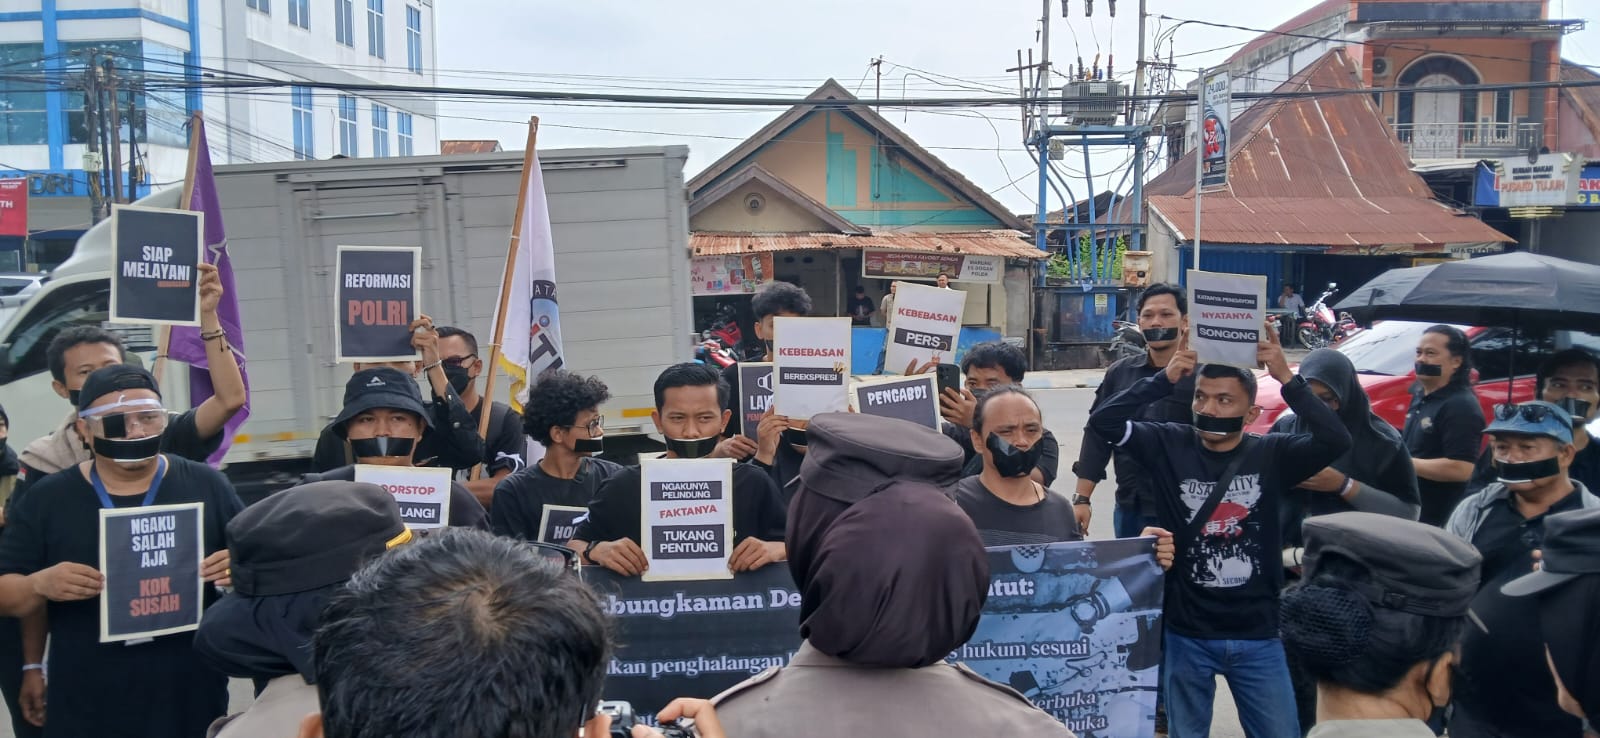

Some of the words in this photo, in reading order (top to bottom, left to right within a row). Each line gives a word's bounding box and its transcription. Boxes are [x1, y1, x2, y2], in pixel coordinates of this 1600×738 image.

[142, 245, 173, 263] SIAP
[123, 261, 191, 281] MELAYANI
[345, 273, 411, 289] REFORMASI
[348, 300, 408, 326] POLRI
[898, 307, 957, 323] KEBEBASAN
[1201, 312, 1253, 320] NYATANYA
[906, 332, 941, 347] PERS
[1200, 328, 1256, 340] SONGONG
[779, 348, 844, 357] KEBEBASAN
[784, 373, 837, 381] BEREKSPRESI
[867, 385, 927, 406] PENGABDI
[661, 482, 709, 491] NGAKUNYA
[662, 491, 711, 499] PELINDUNG
[400, 507, 435, 518] LANGI
[659, 504, 717, 519] FAKTANYA
[131, 515, 176, 534] NGAKU
[132, 532, 175, 551] SALAH
[663, 530, 714, 541] TUKANG
[660, 542, 718, 553] PENTUNG
[141, 550, 168, 568] AJA
[139, 577, 171, 596] KOK
[130, 594, 180, 617] SUSAH
[770, 589, 801, 608] De
[963, 643, 1026, 658] hukum
[1031, 639, 1088, 656] sesuai
[651, 656, 783, 678] penghalangan
[1065, 715, 1106, 732] buka
